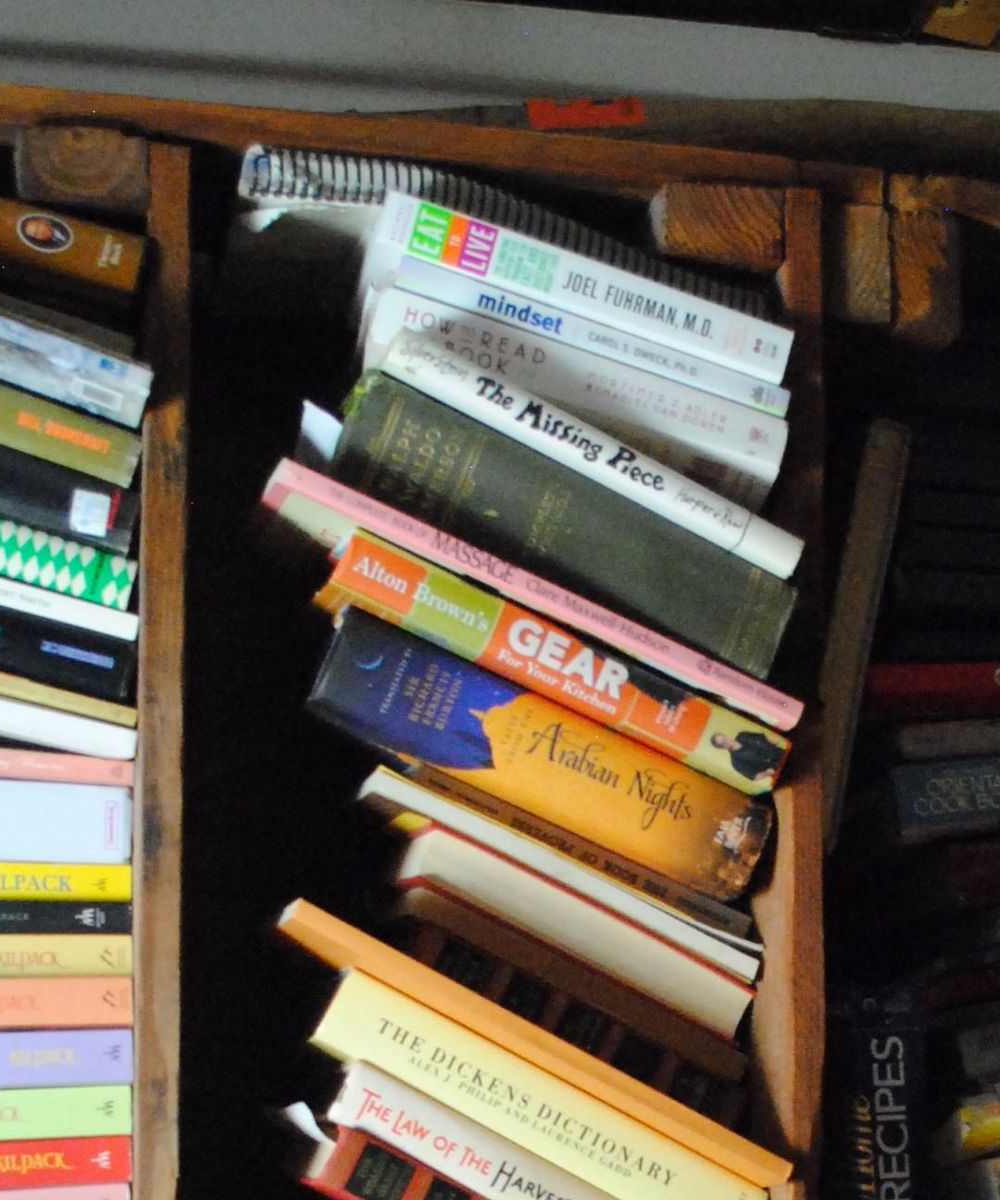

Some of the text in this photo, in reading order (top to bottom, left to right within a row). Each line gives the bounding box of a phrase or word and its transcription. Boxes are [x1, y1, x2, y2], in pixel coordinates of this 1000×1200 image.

[412, 202, 442, 255] EAT
[461, 222, 497, 275] LIVE
[405, 307, 547, 365] HOW READ
[478, 292, 564, 335] mindset
[562, 271, 714, 339] JOEL FUHRMAN, M.D.
[476, 376, 514, 411] The
[515, 399, 603, 462] Missing
[605, 445, 666, 492] Piece
[352, 554, 491, 634] Alton Brown's
[430, 532, 515, 586] MASSAGE
[496, 647, 523, 673] For
[524, 661, 560, 692] Your
[561, 676, 619, 717] Kitchen
[507, 617, 630, 700] GEAR
[526, 722, 693, 830] Arabian Nights
[358, 1087, 392, 1123] THE
[392, 1109, 431, 1143] LAW
[433, 1135, 458, 1160] OF
[458, 1145, 493, 1177] THE
[377, 1018, 679, 1188] THE DICKENS DICTIONARY
